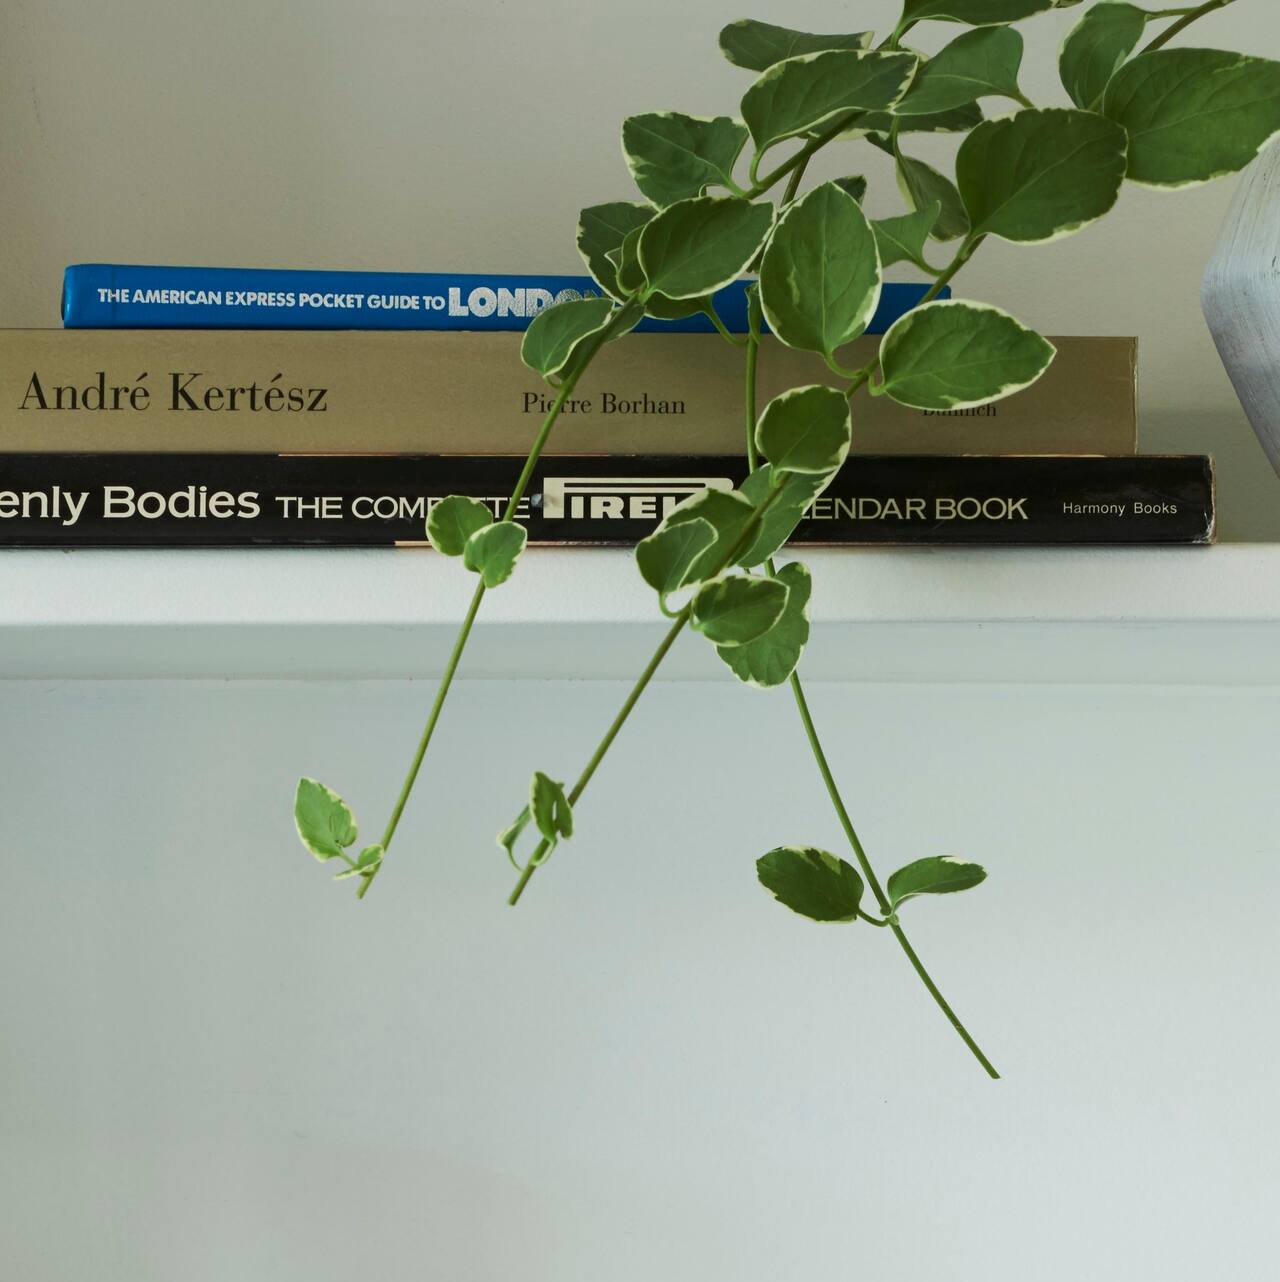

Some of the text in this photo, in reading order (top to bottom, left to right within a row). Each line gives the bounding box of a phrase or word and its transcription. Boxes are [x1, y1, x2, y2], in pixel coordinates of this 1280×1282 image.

[98, 287, 130, 304] THE
[132, 288, 222, 306] AMERICAN
[225, 290, 296, 308] EXPRESS
[298, 292, 364, 309] POCKET
[367, 295, 420, 310] GUIDE
[422, 296, 445, 310] TO
[18, 371, 328, 413] André Kertész
[600, 393, 685, 415] Borhan
[103, 485, 260, 519] Bodies
[275, 496, 342, 518] THE
[351, 496, 530, 519] COMTE
[936, 498, 1028, 520] BOOK
[1063, 502, 1126, 517] Harmony
[1134, 502, 1177, 515] Books
